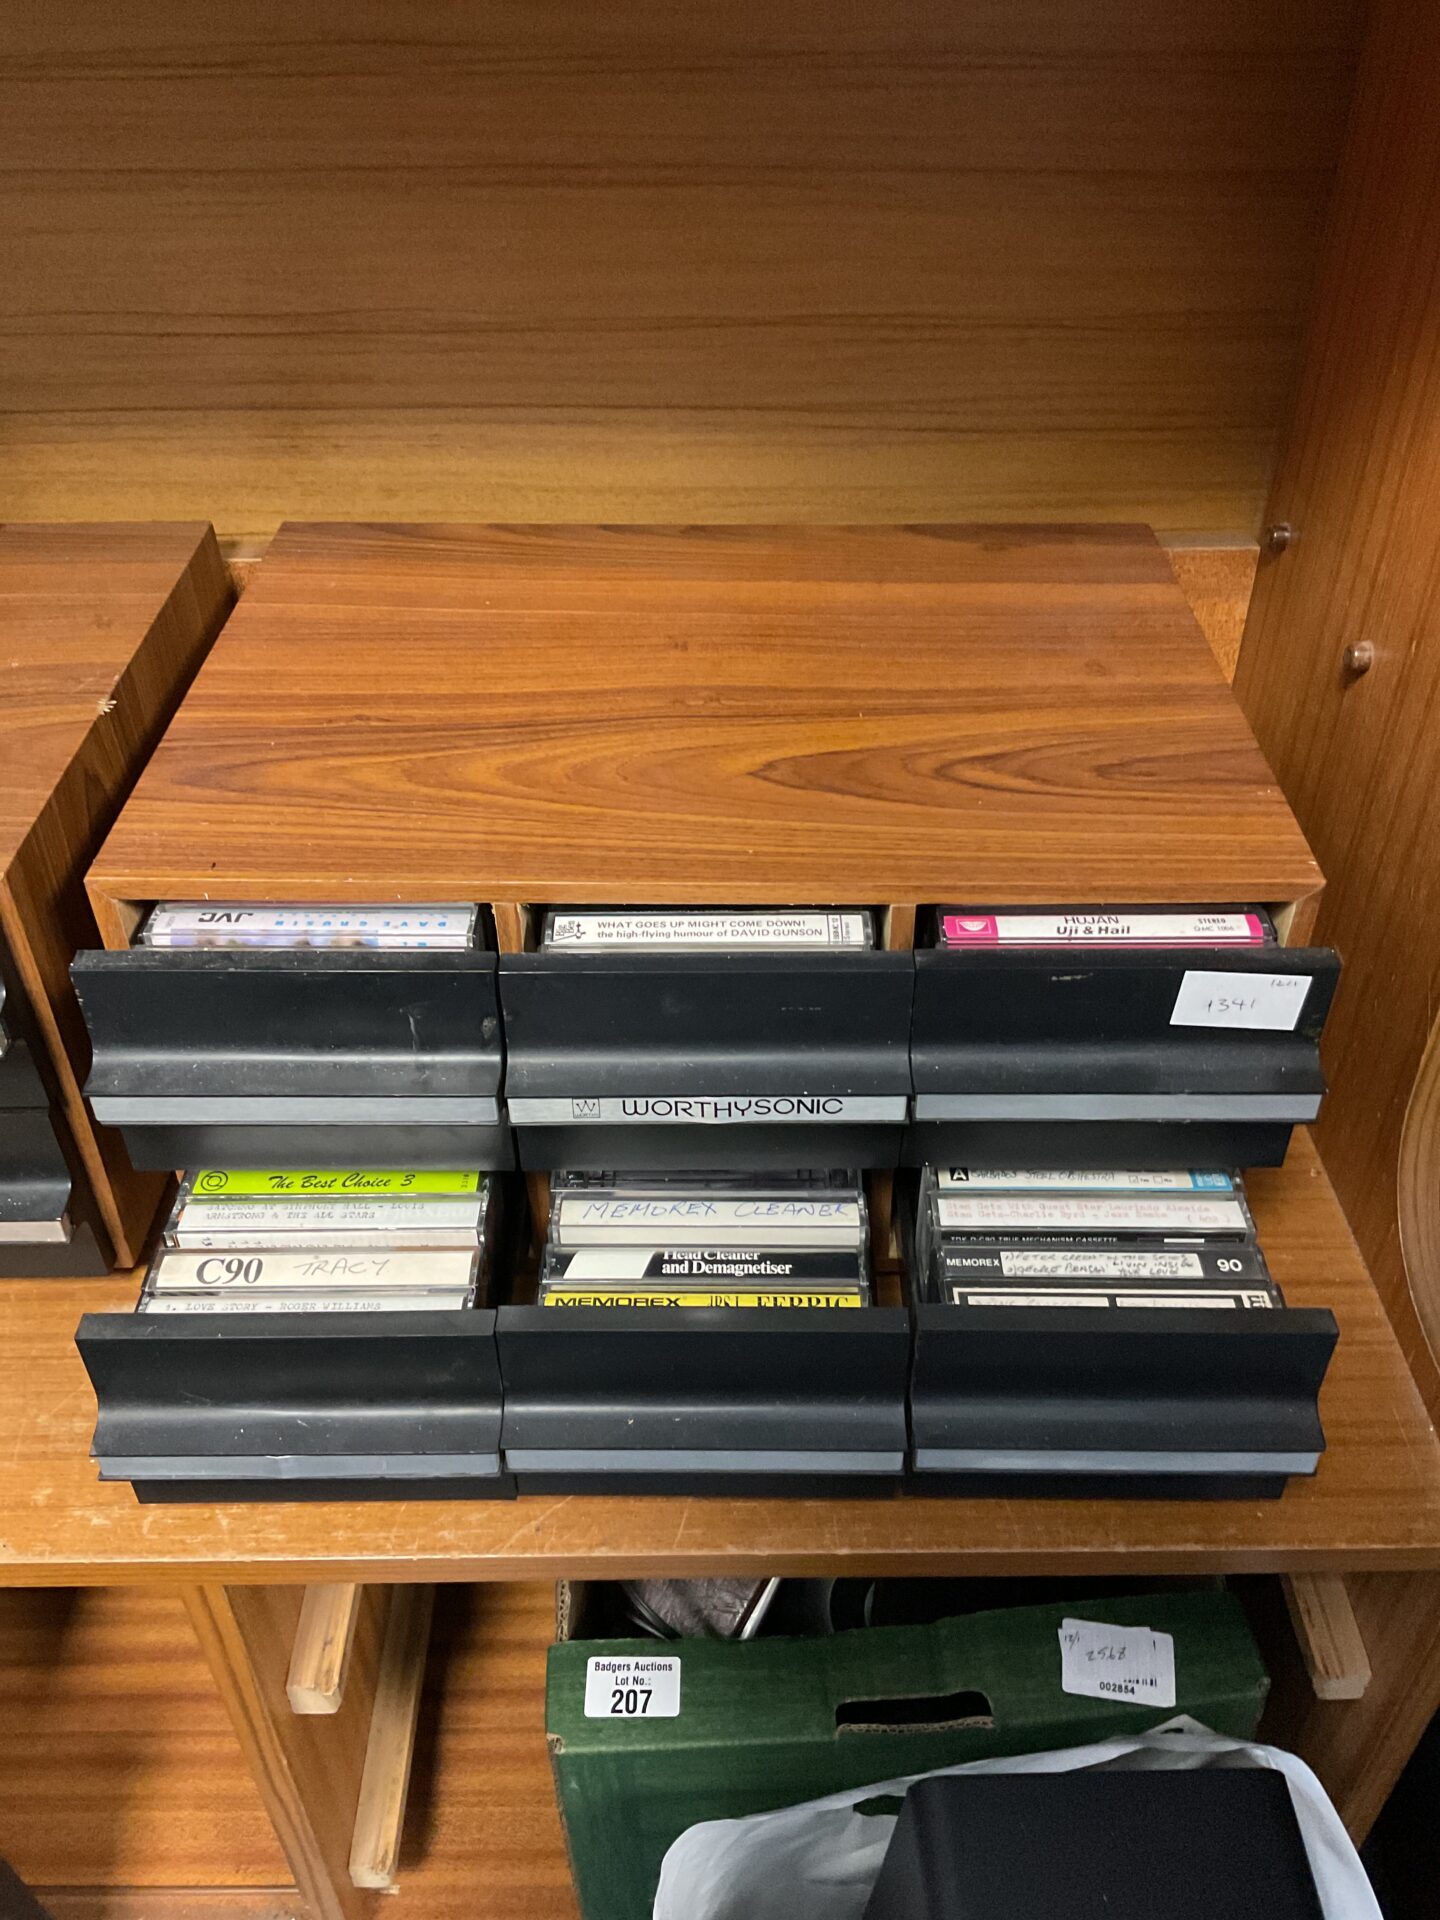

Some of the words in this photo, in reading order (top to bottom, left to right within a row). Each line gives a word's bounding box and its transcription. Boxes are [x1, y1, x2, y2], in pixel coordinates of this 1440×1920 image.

[597, 921, 632, 929] WHAT
[730, 920, 763, 928] COME
[1064, 916, 1119, 925] HUJAN
[597, 930, 613, 938] the
[617, 930, 671, 939] high-flying
[674, 929, 713, 937] humour
[716, 929, 728, 937] of
[731, 929, 770, 937] DAVID
[773, 928, 823, 936] GUNSON
[1056, 926, 1078, 937] Uji
[1083, 926, 1093, 935] &
[1098, 925, 1131, 935] Hail
[1207, 998, 1256, 1012] 1341
[622, 1097, 844, 1118] WORTHYSONIC
[268, 1175, 293, 1189] The
[300, 1175, 337, 1189] Best
[341, 1172, 392, 1188] Choice
[400, 1174, 416, 1187] 3
[953, 1169, 967, 1180] A
[582, 1200, 717, 1219] MEMOREX
[734, 1200, 850, 1218] CLEANER
[663, 1251, 702, 1260] Head
[703, 1251, 760, 1261] Cleaner
[946, 1257, 1000, 1267] MEMOREX
[196, 1257, 264, 1285] C90
[293, 1257, 391, 1276] TRACY
[661, 1260, 689, 1274] and
[691, 1260, 793, 1277] Demagnetiser
[1216, 1258, 1243, 1272] 90
[185, 1303, 216, 1311] LOVE
[222, 1303, 259, 1311] STORY
[279, 1302, 317, 1311] ROGER
[323, 1302, 383, 1311] WILLIAMS
[555, 1297, 682, 1307] MEMOREX
[595, 1661, 631, 1673] Badgers
[634, 1661, 673, 1671] Auctions
[615, 1675, 629, 1686] Lot
[632, 1675, 652, 1686] No.:
[1099, 1681, 1135, 1695] 002854
[611, 1688, 653, 1714] 207
